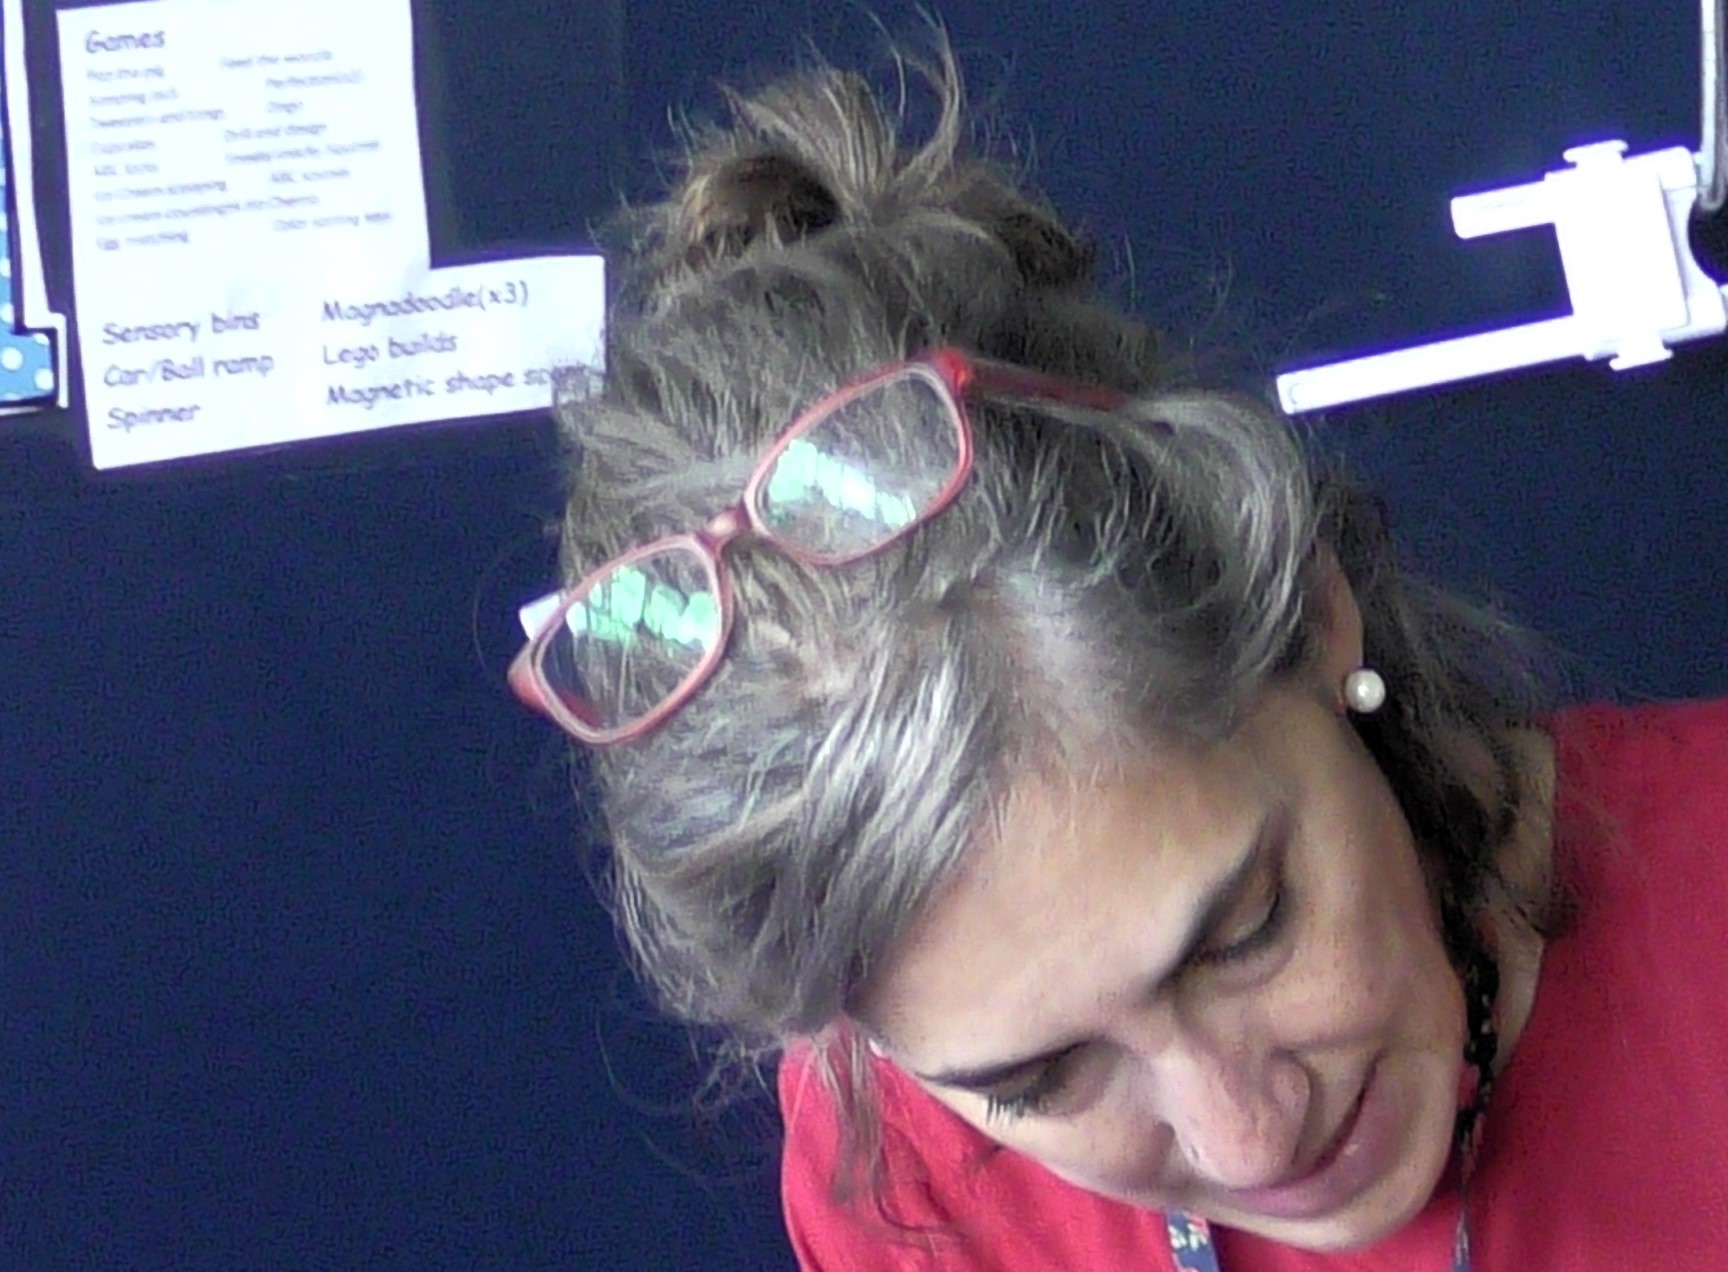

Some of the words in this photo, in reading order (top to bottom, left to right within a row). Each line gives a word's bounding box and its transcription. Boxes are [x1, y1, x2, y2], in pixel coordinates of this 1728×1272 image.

[85, 29, 165, 54] Games
[102, 321, 201, 345] Sensory
[211, 311, 260, 334] bins
[323, 344, 380, 369] Lego
[388, 331, 459, 359] builds
[103, 354, 205, 388] Car/Ball
[213, 354, 274, 379] ramp
[326, 374, 436, 411] Magnetic
[444, 369, 516, 397] shape
[106, 404, 202, 434] Spinner
